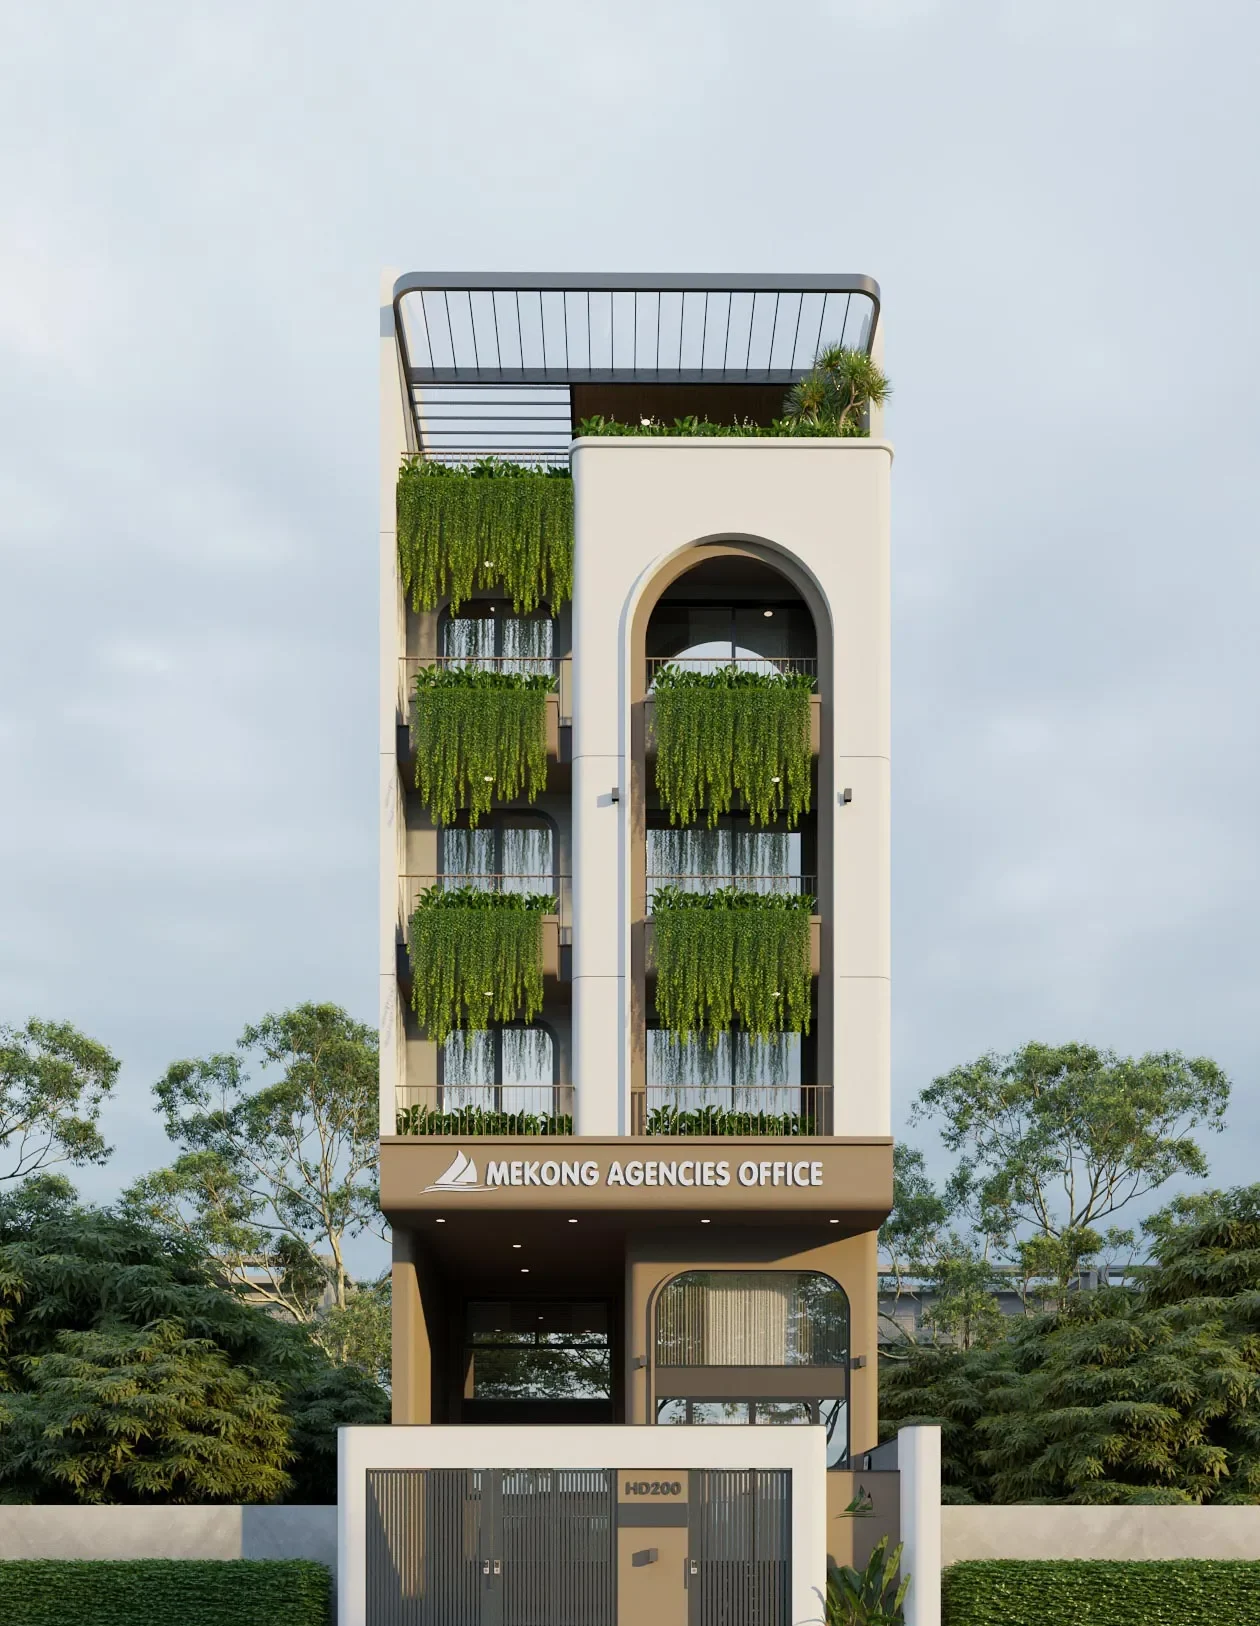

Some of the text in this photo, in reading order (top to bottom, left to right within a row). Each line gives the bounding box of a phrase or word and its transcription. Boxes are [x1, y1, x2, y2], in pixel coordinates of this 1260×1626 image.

[485, 1160, 824, 1188] MEKONG AGENCIES OFFICE
[625, 1482, 682, 1496] HD200
